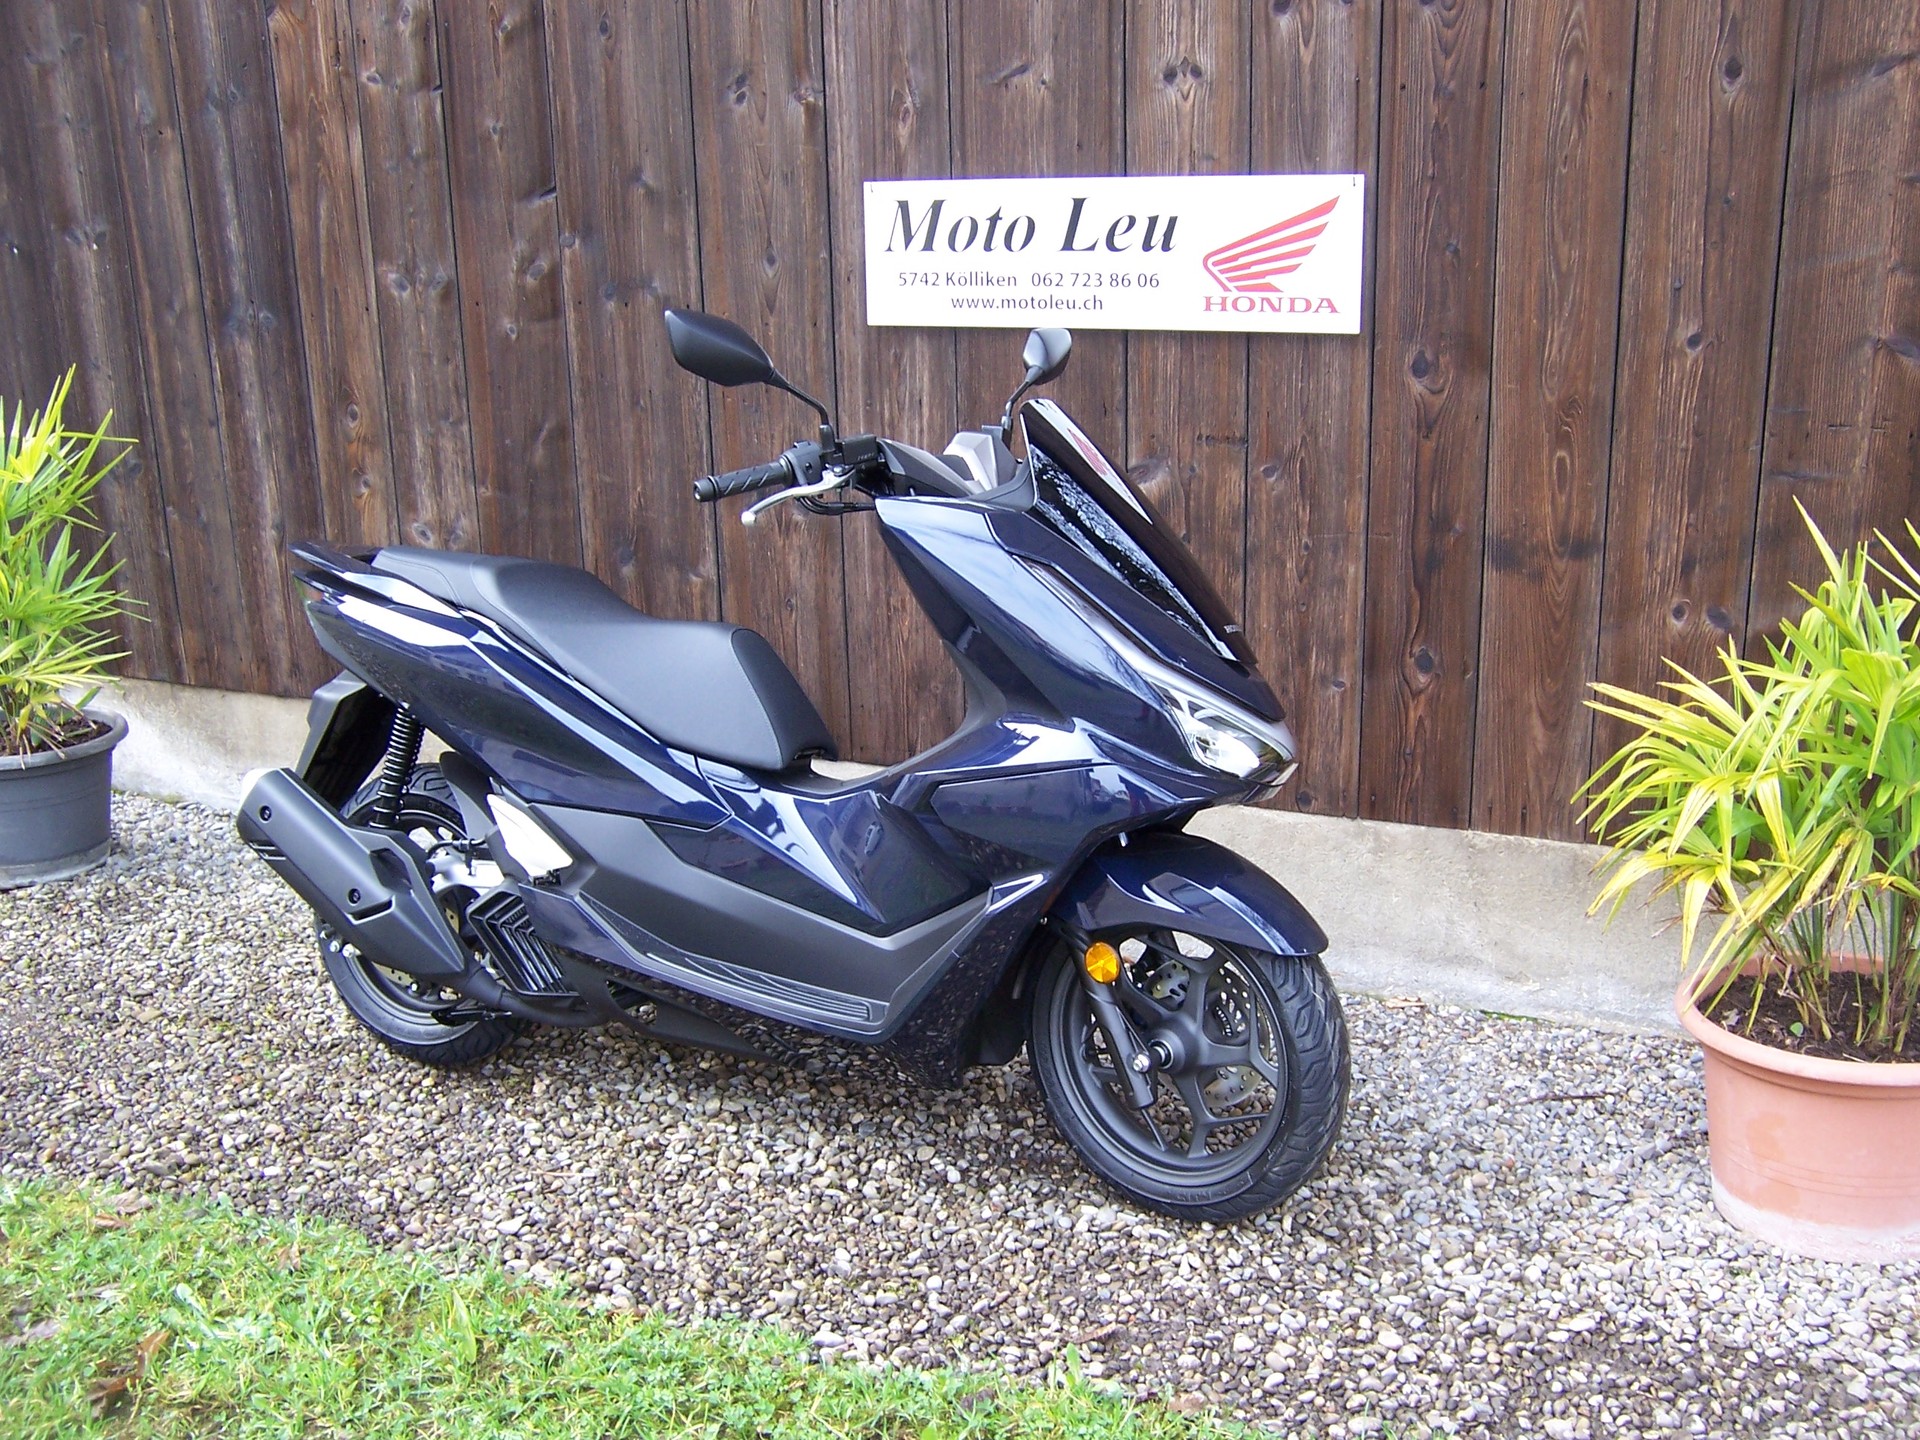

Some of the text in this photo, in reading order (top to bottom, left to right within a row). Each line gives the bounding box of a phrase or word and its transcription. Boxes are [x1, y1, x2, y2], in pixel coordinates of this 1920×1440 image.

[885, 197, 1179, 253] Moto Leu
[899, 270, 1160, 288] 5742 Kölliken 062 723 86 06
[951, 294, 1103, 311] www.motoleu.ch
[1203, 296, 1341, 314] HONDA
